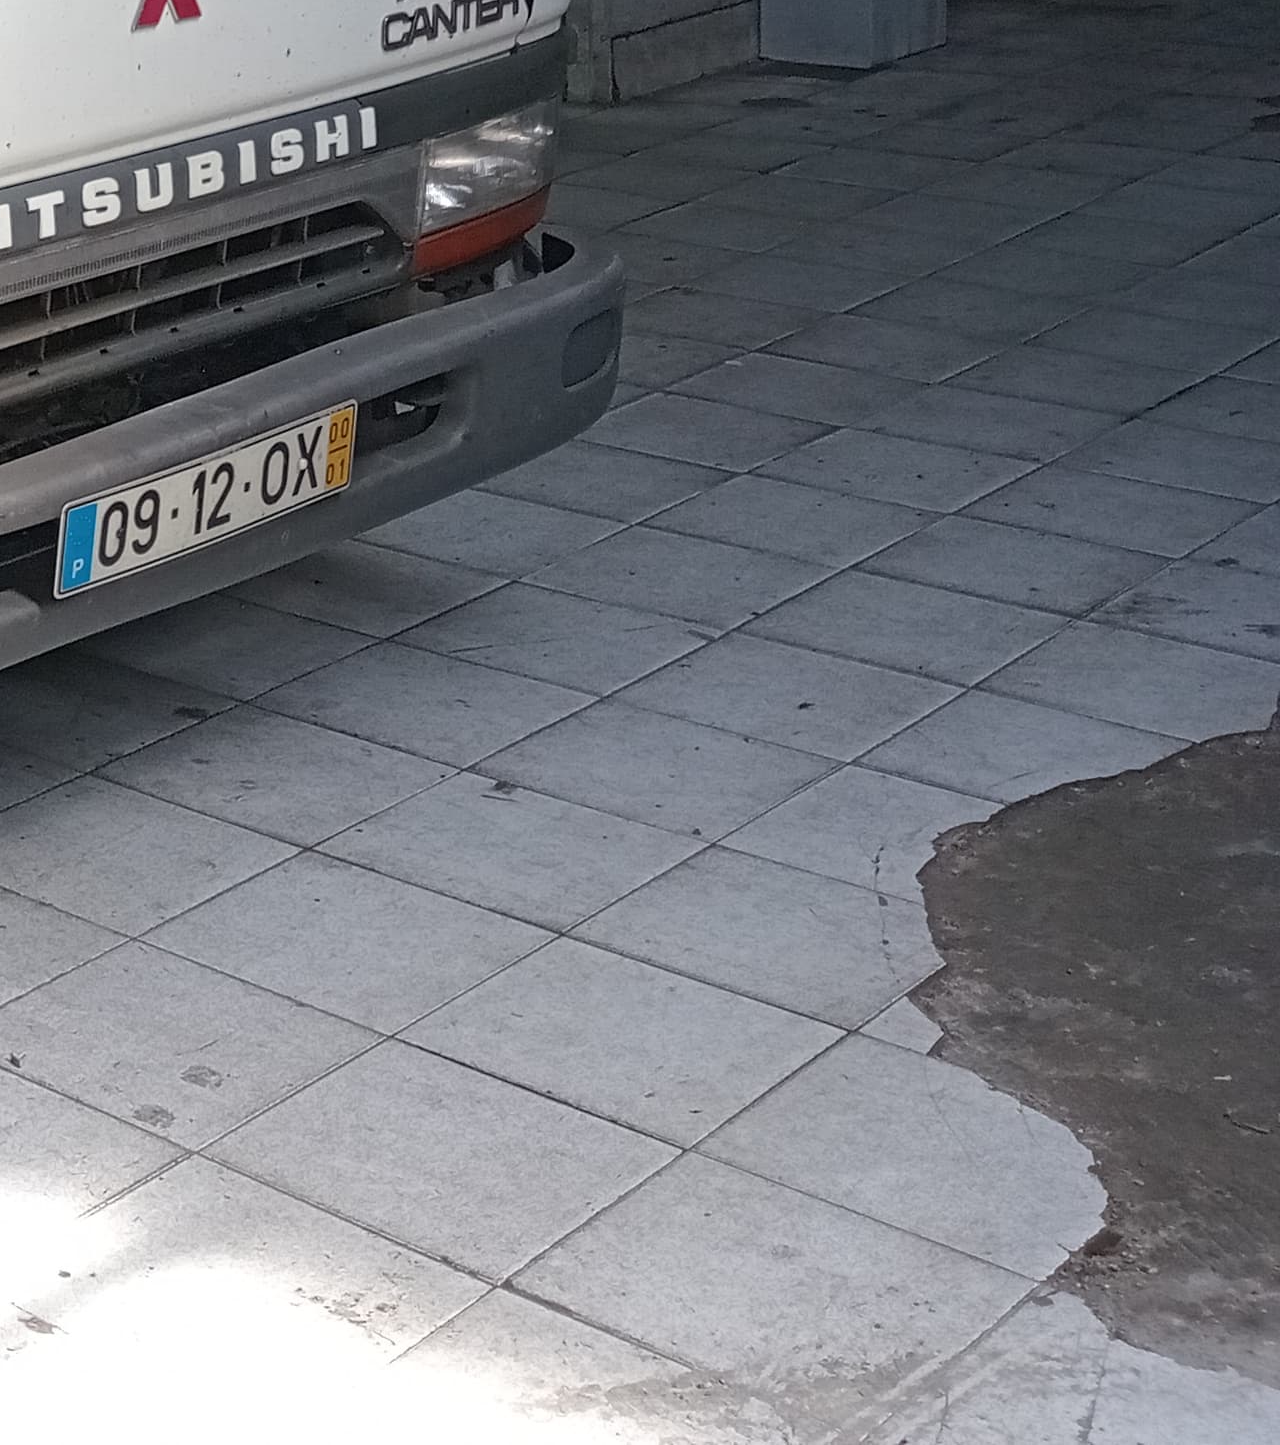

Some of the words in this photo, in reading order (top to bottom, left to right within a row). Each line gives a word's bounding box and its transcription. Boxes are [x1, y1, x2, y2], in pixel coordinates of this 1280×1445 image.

[329, 417, 350, 444] 00
[326, 456, 346, 486] 01
[71, 558, 84, 579] P
